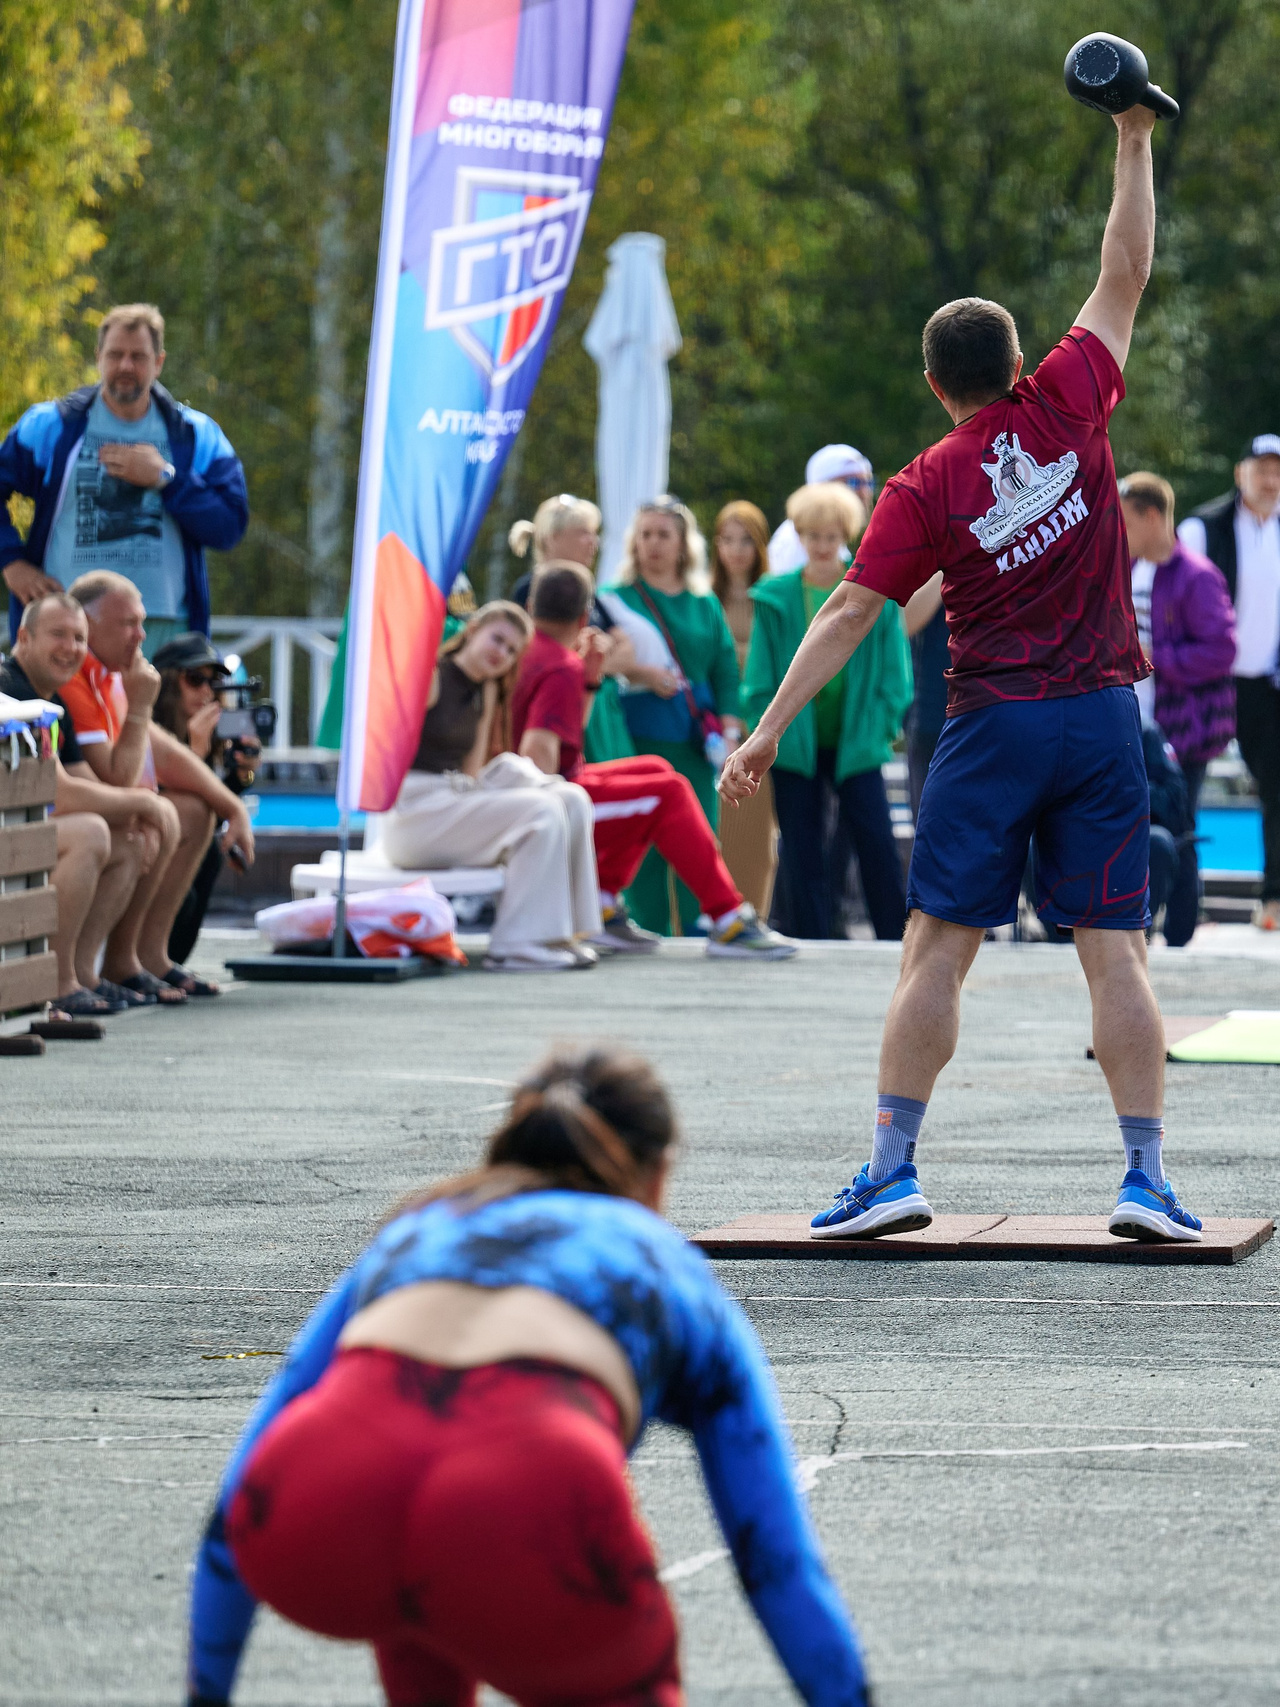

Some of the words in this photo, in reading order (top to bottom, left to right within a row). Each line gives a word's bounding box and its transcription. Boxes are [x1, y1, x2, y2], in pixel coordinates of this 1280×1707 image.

[448, 93, 602, 131] ФЕДЕРАЦИЯ
[454, 222, 568, 306] ГТО
[988, 495, 1043, 537] АДВОАТСКАЯ
